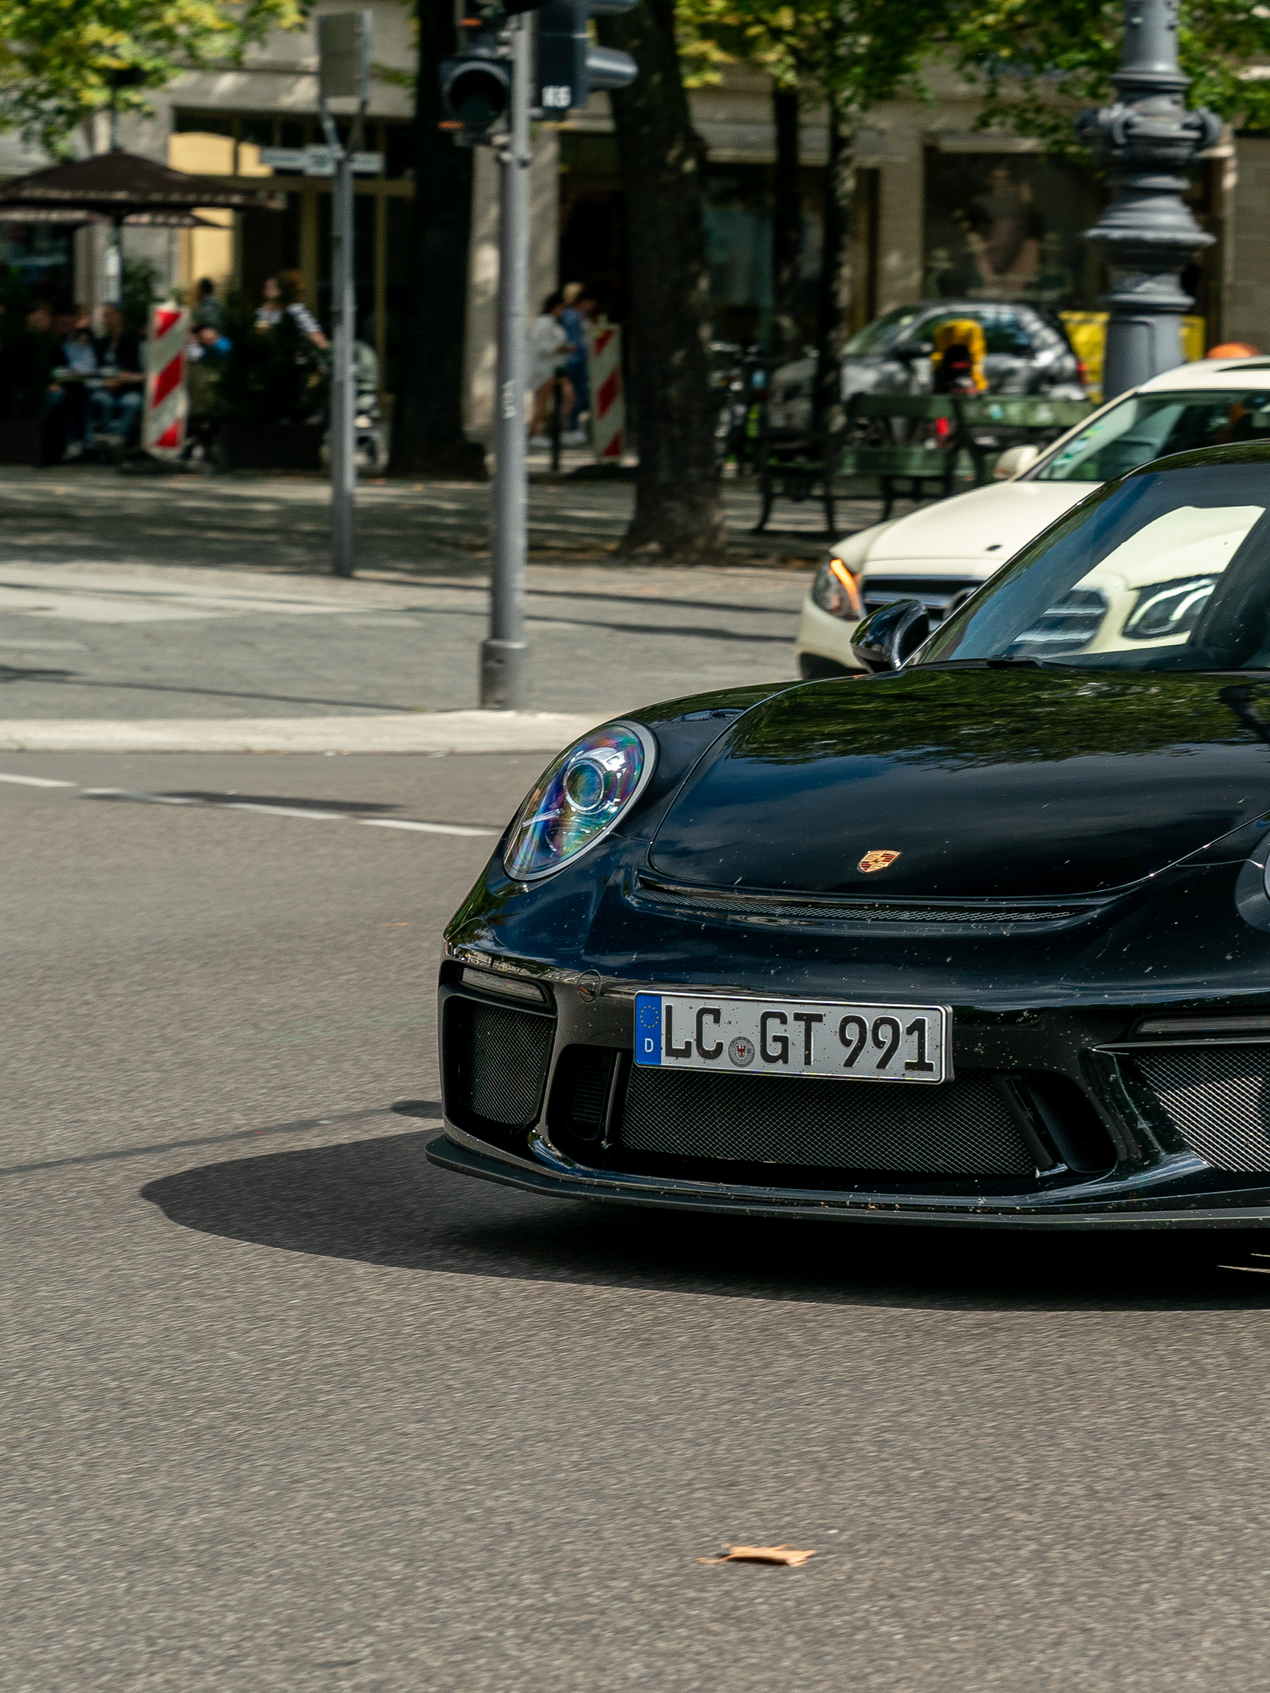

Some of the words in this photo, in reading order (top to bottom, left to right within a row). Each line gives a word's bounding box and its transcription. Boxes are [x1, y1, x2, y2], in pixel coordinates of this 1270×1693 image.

[644, 1038, 654, 1053] D
[665, 1004, 724, 1060] LC
[760, 1010, 823, 1066] GT
[838, 1014, 935, 1072] 991
